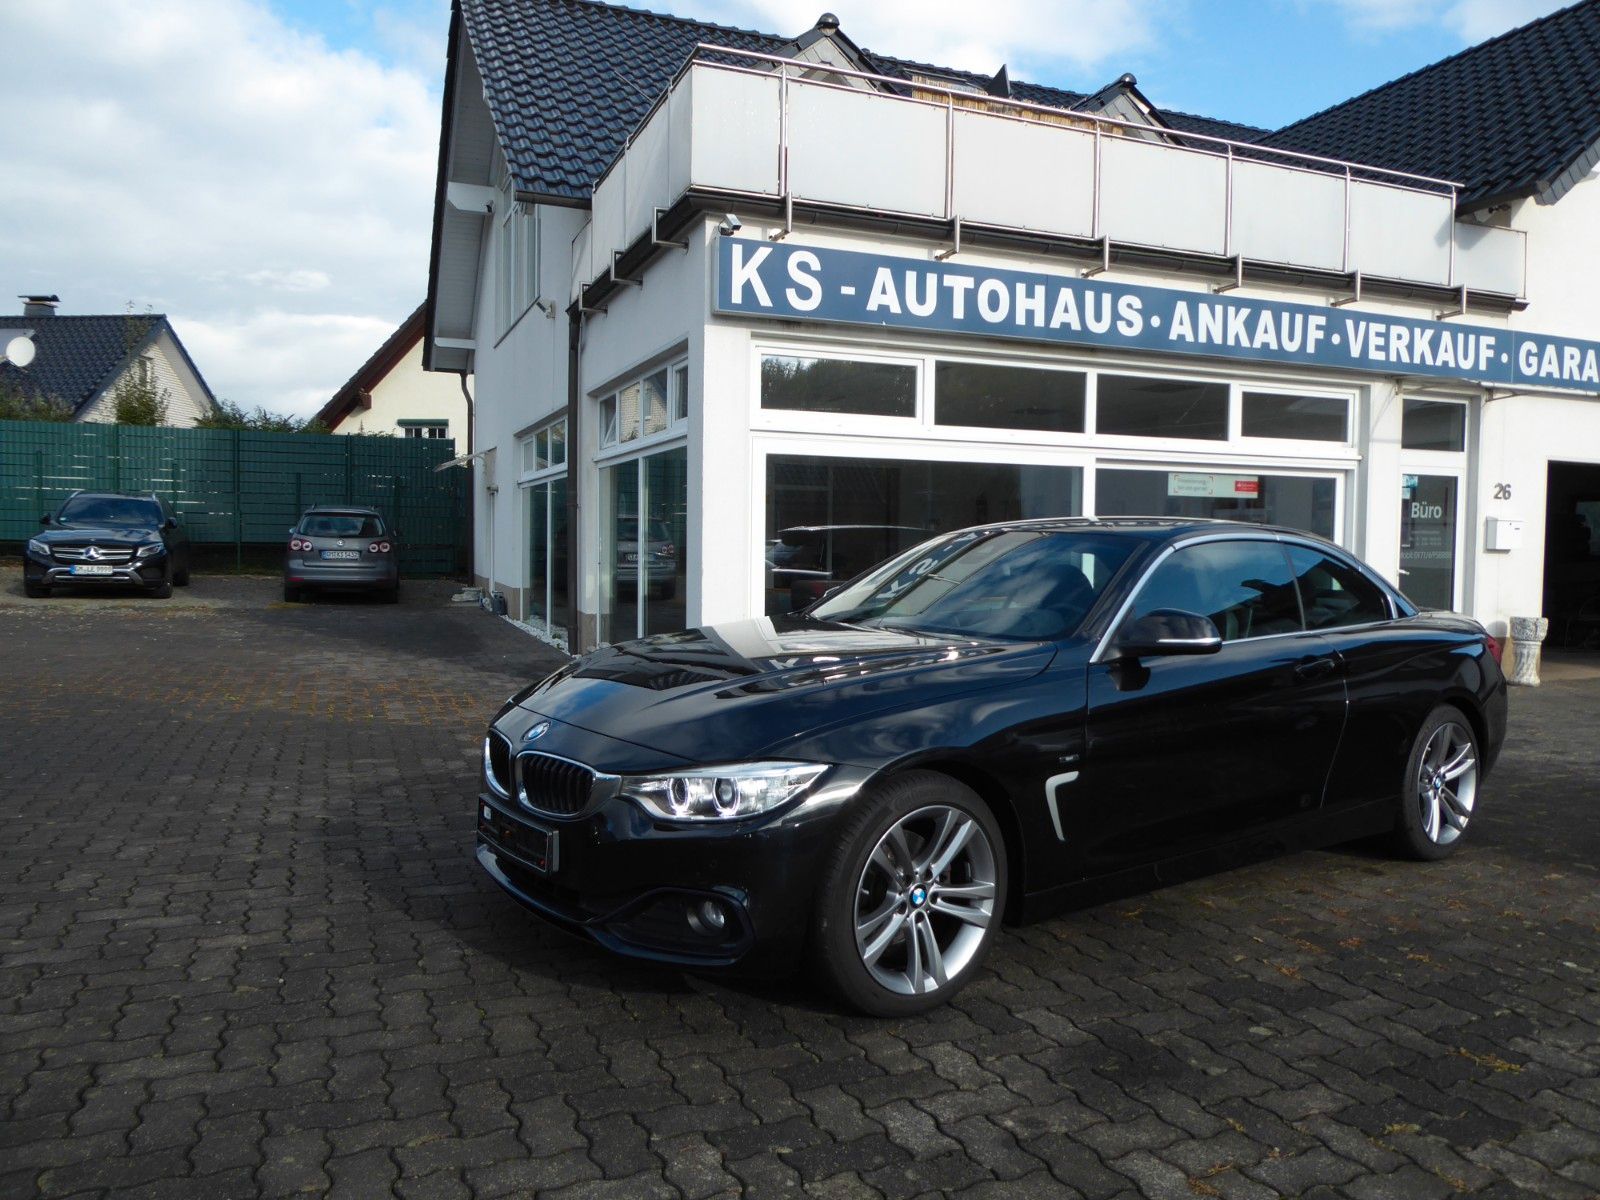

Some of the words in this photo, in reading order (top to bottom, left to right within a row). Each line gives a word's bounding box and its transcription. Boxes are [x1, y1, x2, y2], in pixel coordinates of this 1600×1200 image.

[730, 243, 823, 311] KS
[866, 266, 1144, 337] AUTOHAUS
[1168, 300, 1327, 354] ANKAUF
[1345, 318, 1496, 371] VERKAUF
[1518, 340, 1600, 383] GARA
[1493, 482, 1512, 501] 26
[1411, 501, 1442, 519] Büro
